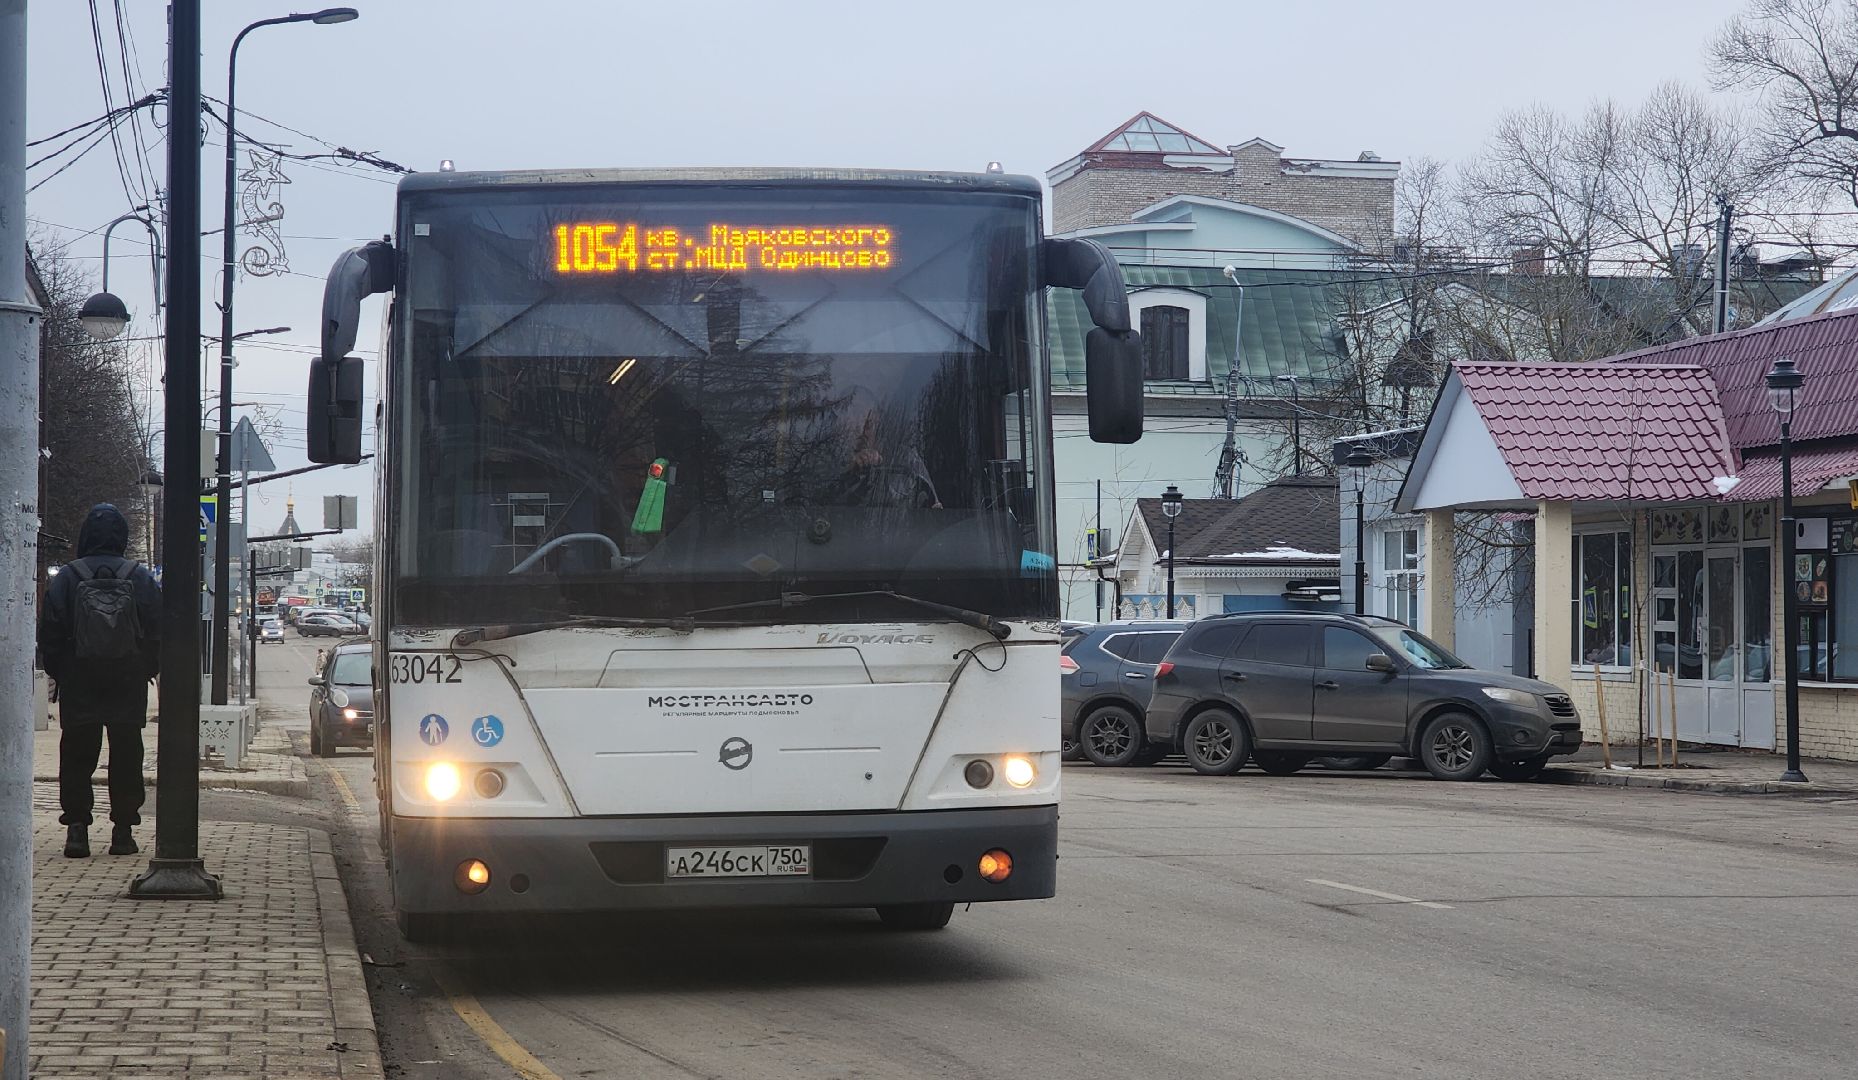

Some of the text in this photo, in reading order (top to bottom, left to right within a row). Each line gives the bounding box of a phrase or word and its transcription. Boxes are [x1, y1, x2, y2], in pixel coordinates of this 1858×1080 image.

[711, 224, 891, 246] Маяковского
[556, 223, 639, 272] 1054
[760, 246, 891, 270] Одинцово
[816, 632, 936, 645] VOYAGE
[390, 654, 463, 684] 63042
[648, 694, 814, 708] МОСТРАНСАВТО
[676, 848, 803, 874] А246СК 750
[776, 864, 794, 873] RUS
